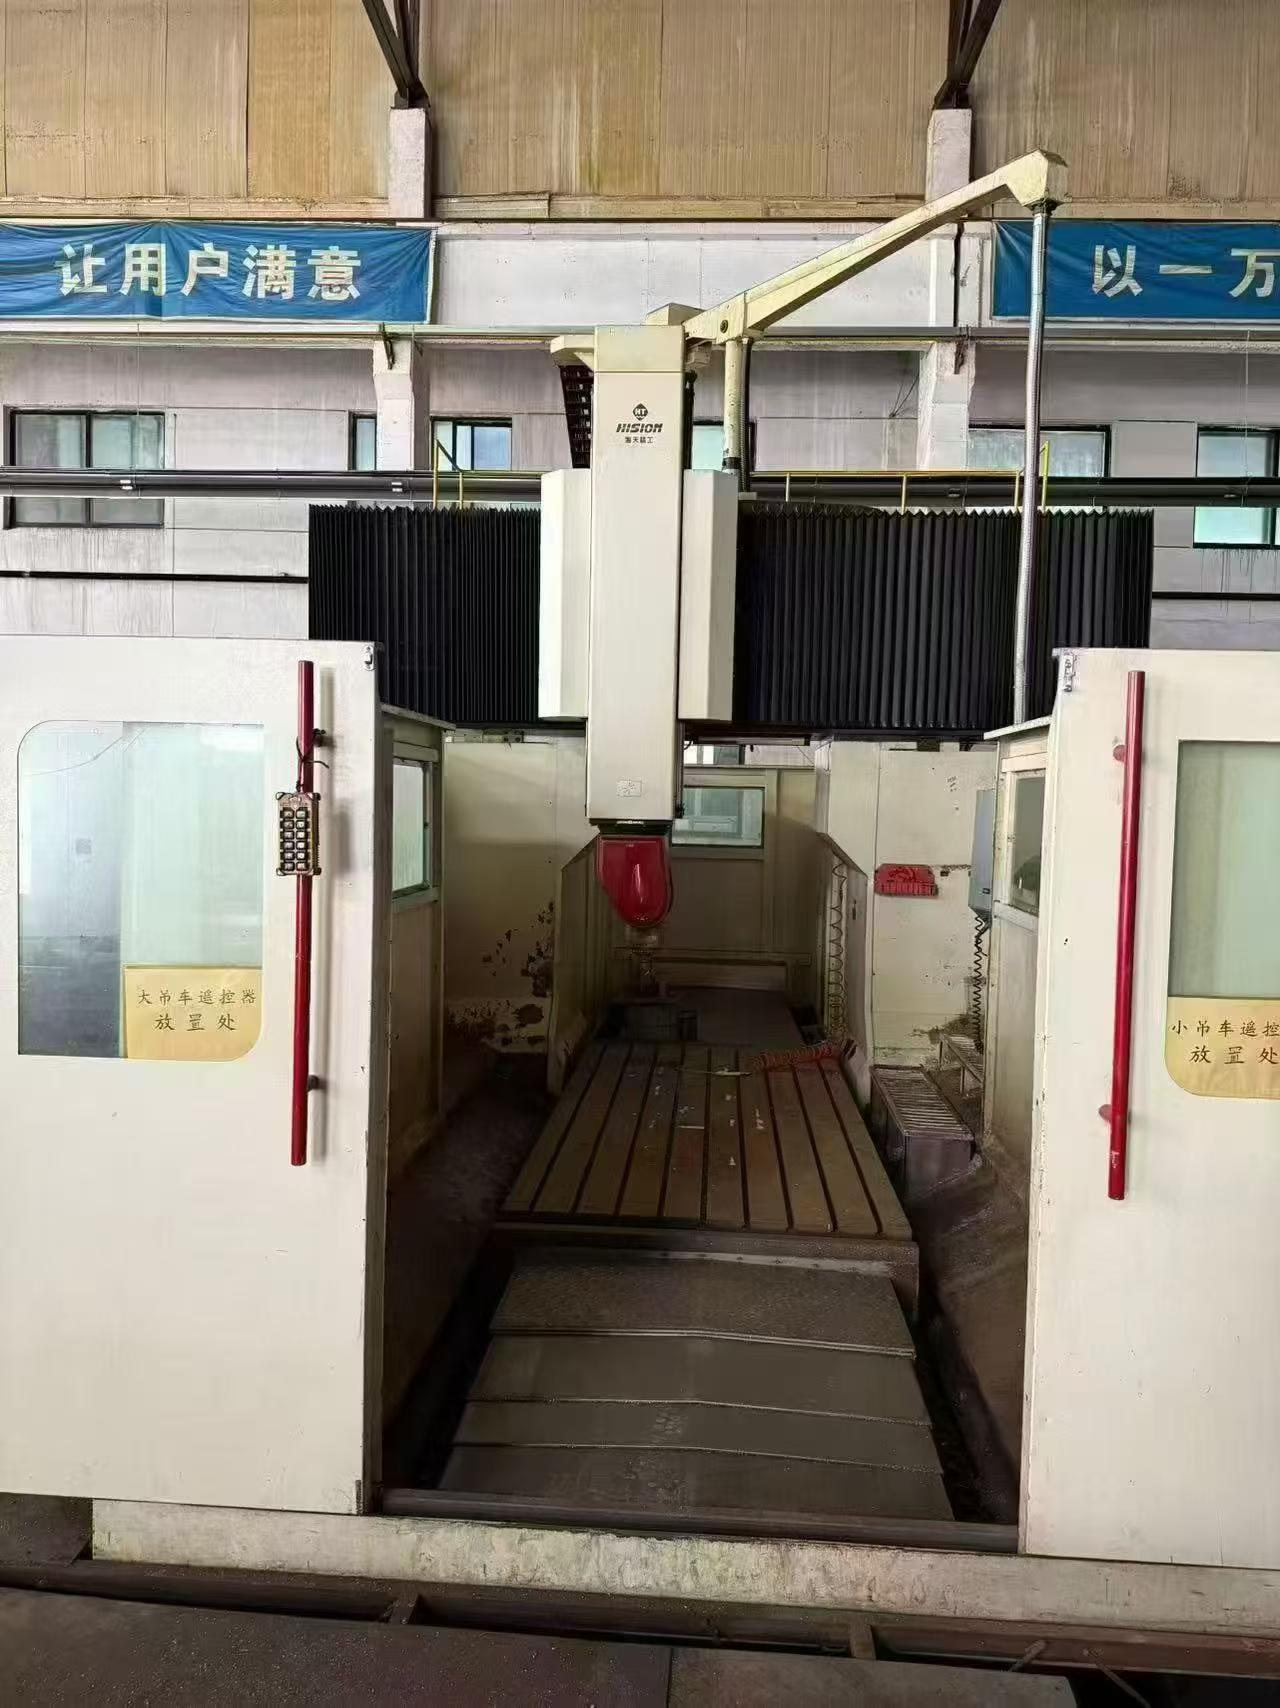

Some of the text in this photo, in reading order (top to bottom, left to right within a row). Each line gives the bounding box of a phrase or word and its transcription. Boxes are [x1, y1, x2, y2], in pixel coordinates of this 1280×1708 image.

[57, 242, 362, 300] 让用户满意
[1092, 244, 1280, 298] 以一万
[137, 988, 257, 1006] 大吊车遥控器
[155, 1013, 237, 1031] 放置处
[1172, 1020, 1280, 1037] 小吊车遥控
[1189, 1045, 1280, 1065] 放置处
